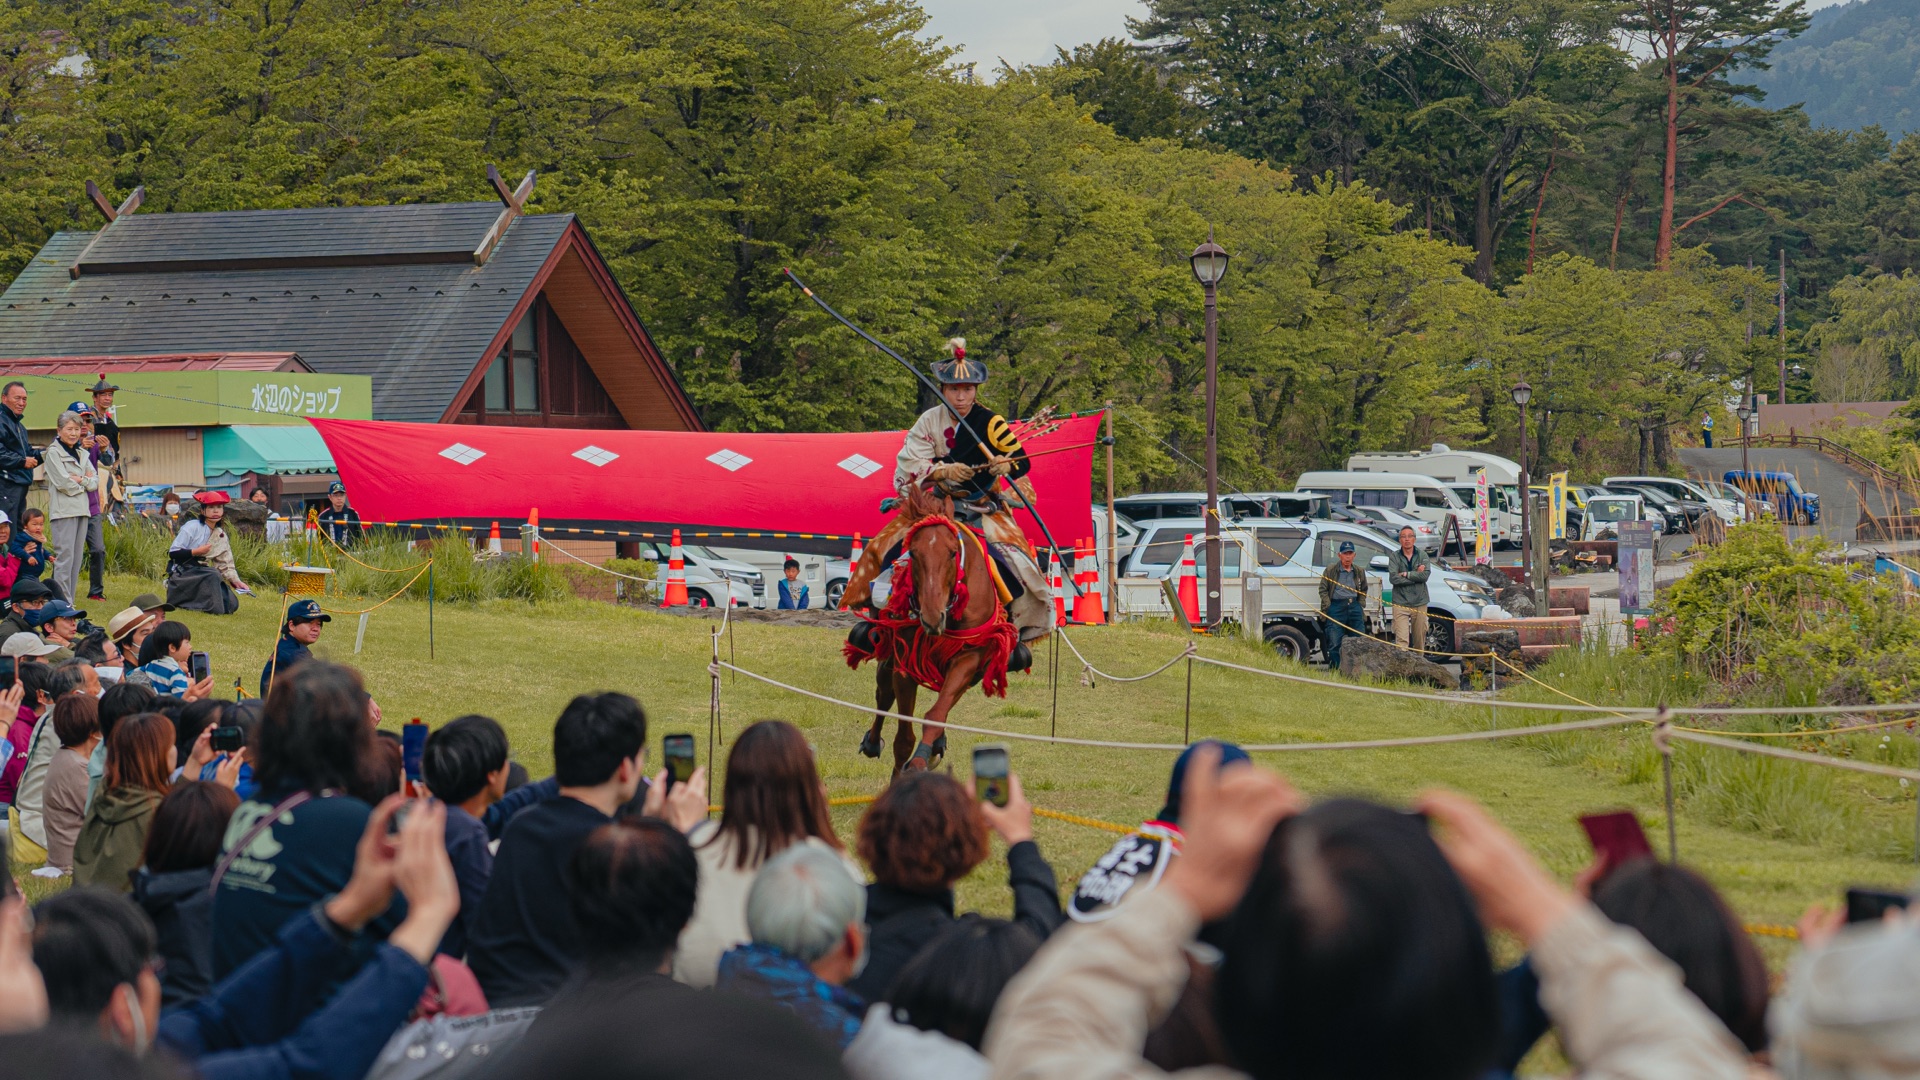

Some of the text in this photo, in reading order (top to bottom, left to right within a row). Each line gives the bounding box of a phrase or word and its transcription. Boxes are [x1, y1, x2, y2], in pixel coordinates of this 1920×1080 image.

[251, 383, 342, 414] 水辺のショップ
